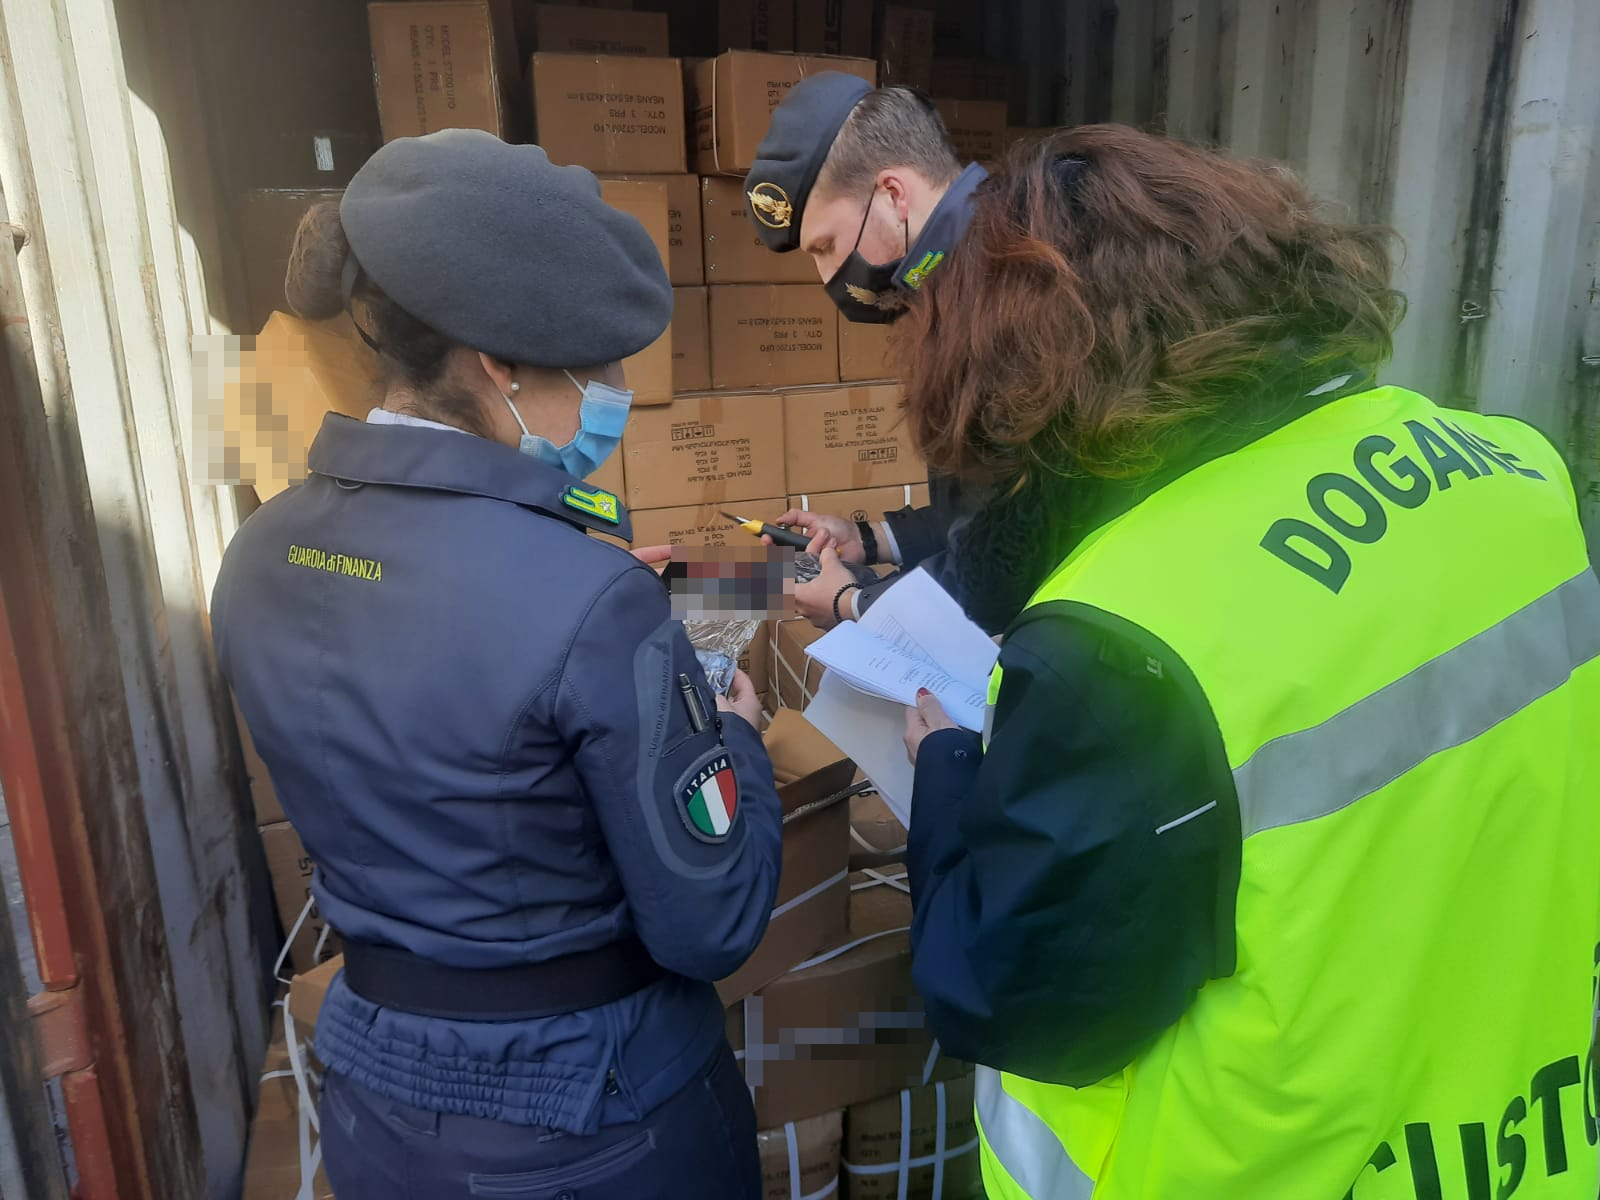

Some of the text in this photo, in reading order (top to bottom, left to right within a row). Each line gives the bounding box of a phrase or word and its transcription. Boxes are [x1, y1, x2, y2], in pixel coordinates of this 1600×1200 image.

[1259, 416, 1547, 595] DOGANE
[288, 545, 382, 582] GUARDIA di FINANZA
[661, 658, 670, 702] FINANZA
[687, 758, 727, 796] ITALIA
